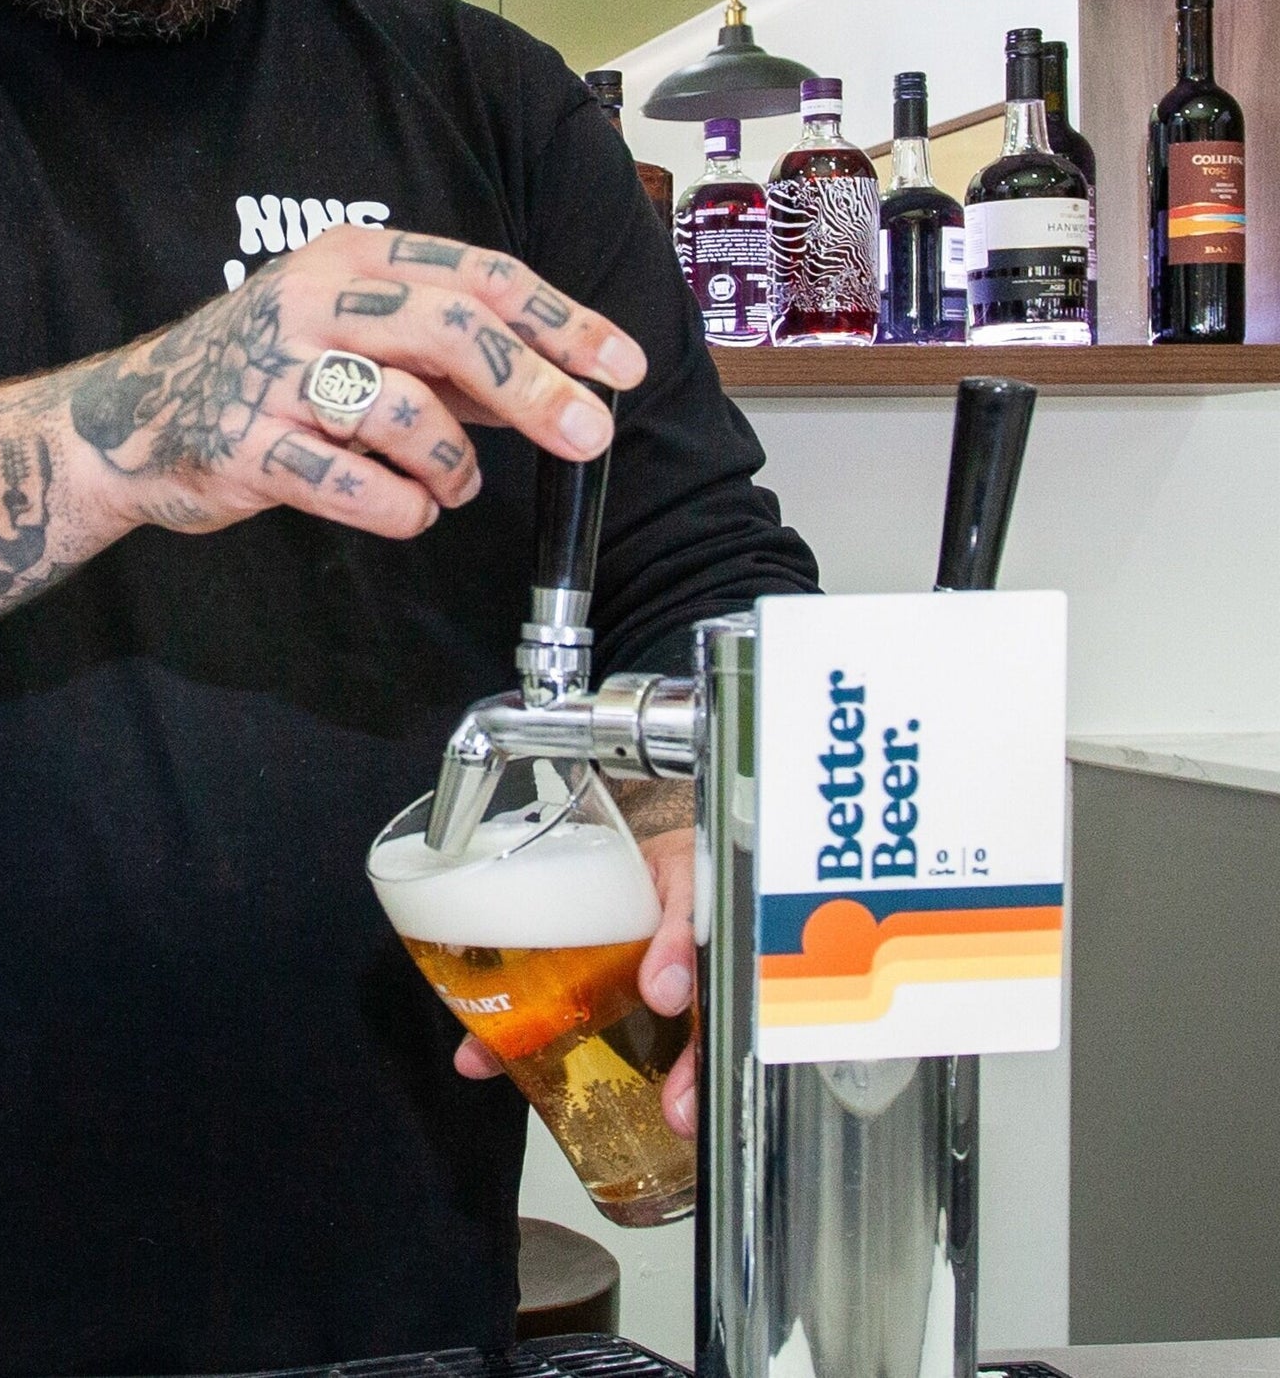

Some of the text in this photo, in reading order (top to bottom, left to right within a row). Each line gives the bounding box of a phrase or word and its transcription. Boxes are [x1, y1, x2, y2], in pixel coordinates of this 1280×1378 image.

[1067, 278, 1081, 297] 10
[816, 669, 866, 882] Better
[871, 718, 921, 880] Beer.
